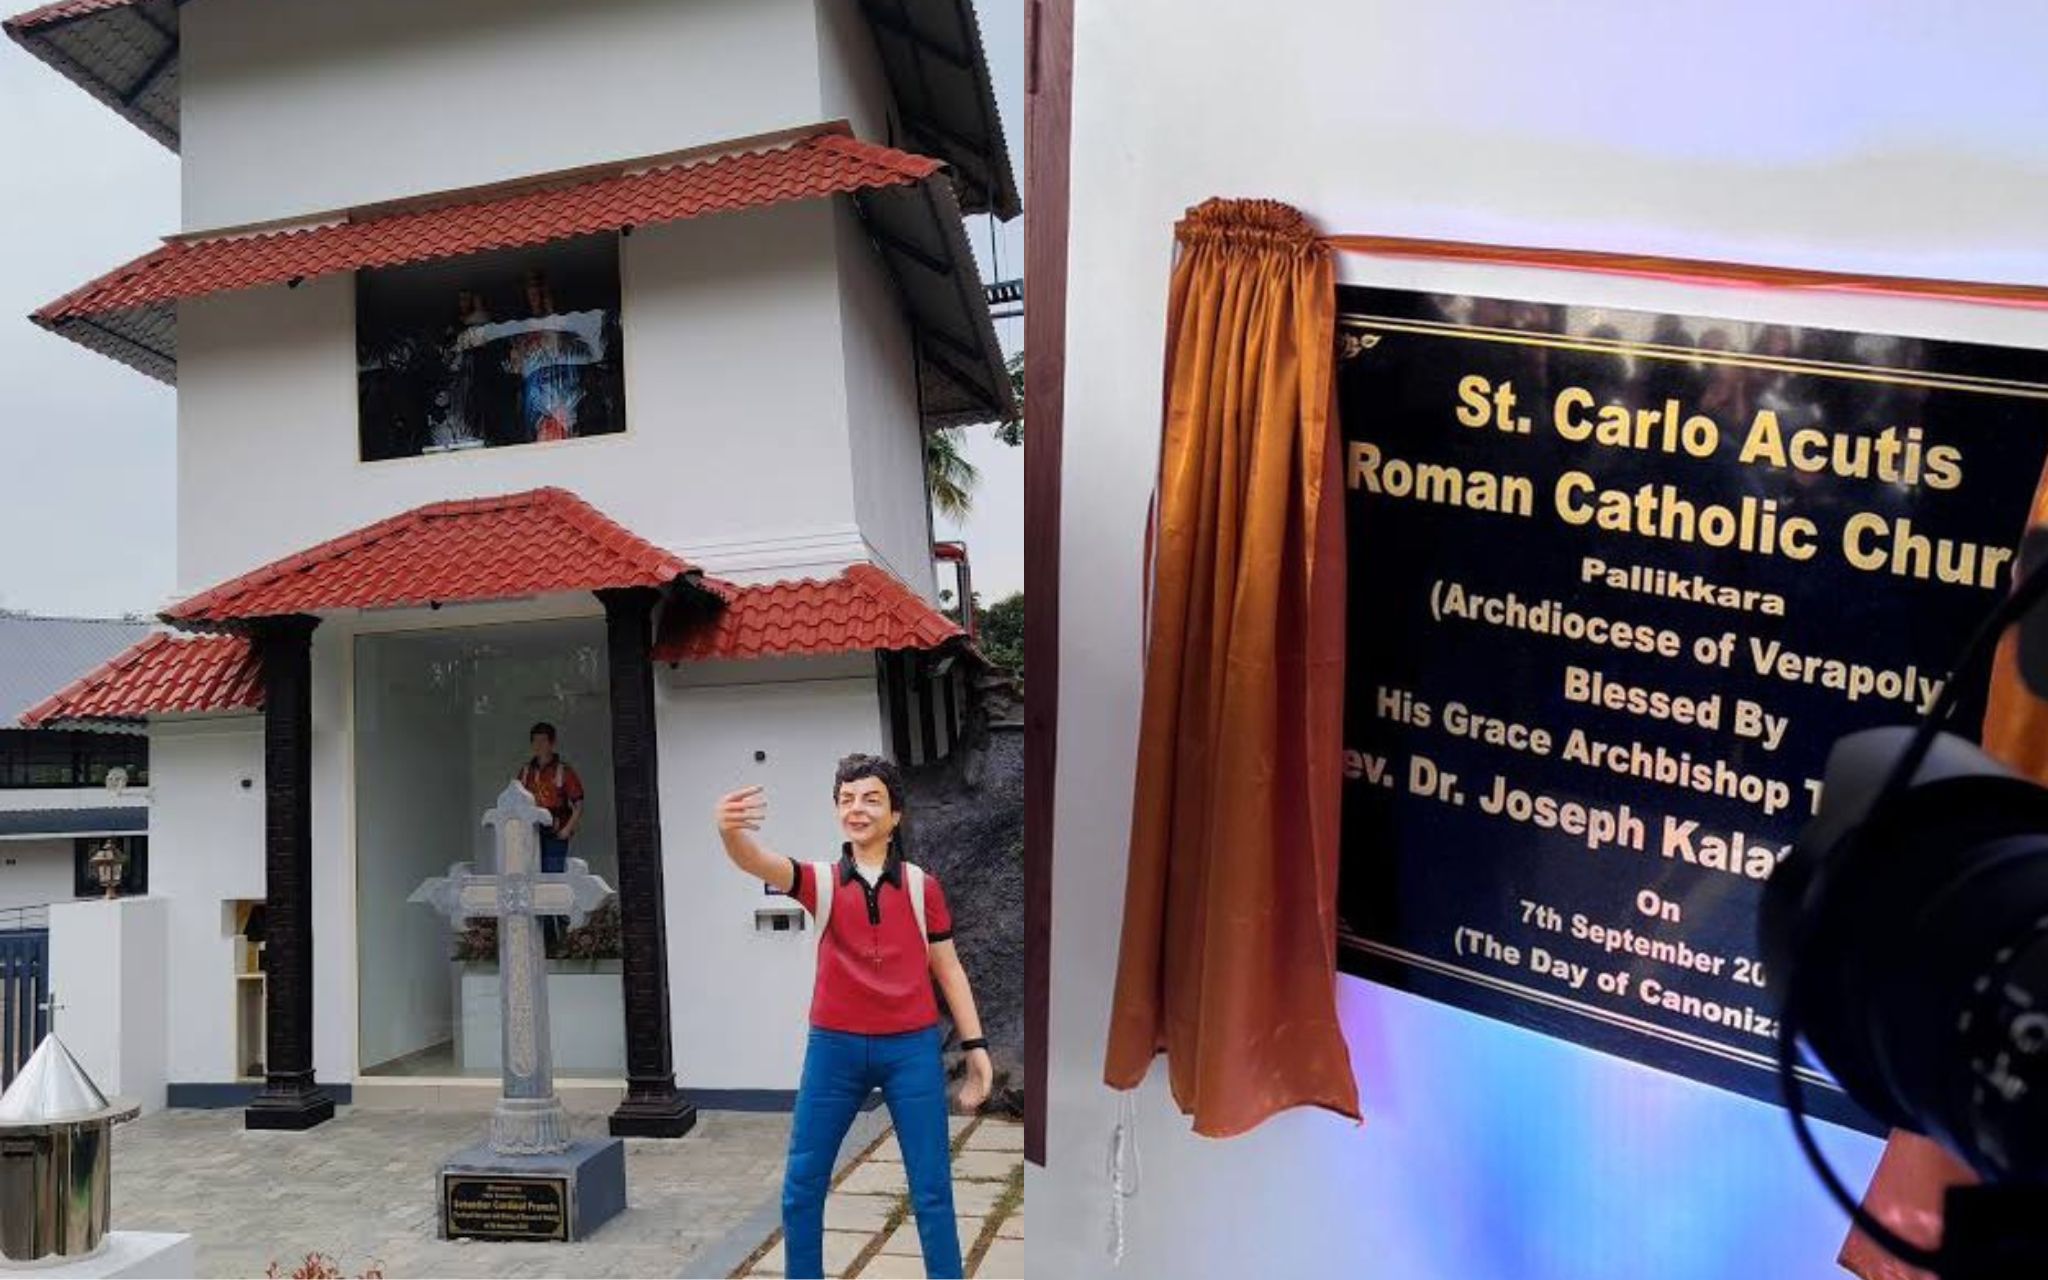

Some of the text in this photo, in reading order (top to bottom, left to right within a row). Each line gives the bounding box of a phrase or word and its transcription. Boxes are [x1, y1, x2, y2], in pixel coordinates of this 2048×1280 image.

[1456, 374, 1963, 490] St. Carlo Acutis
[1346, 440, 2012, 590] Roman Catholic Chur
[1430, 580, 1682, 658] (Archdiocese
[1693, 632, 1737, 668] of
[1581, 557, 1786, 616] Pallikkara
[1377, 687, 1432, 728] His
[1442, 701, 1553, 756] Grace
[1562, 729, 1791, 815] Archbishop
[1564, 666, 1790, 751] Blessed By
[1343, 750, 1394, 788] ev.
[1409, 755, 1465, 806] Dr.
[1478, 774, 1646, 851] Joseph
[1519, 899, 1768, 988] 7th September 20
[1636, 889, 1682, 925] On
[1454, 925, 1522, 967] (The
[1530, 946, 1589, 990] Day
[1597, 970, 1631, 997] of
